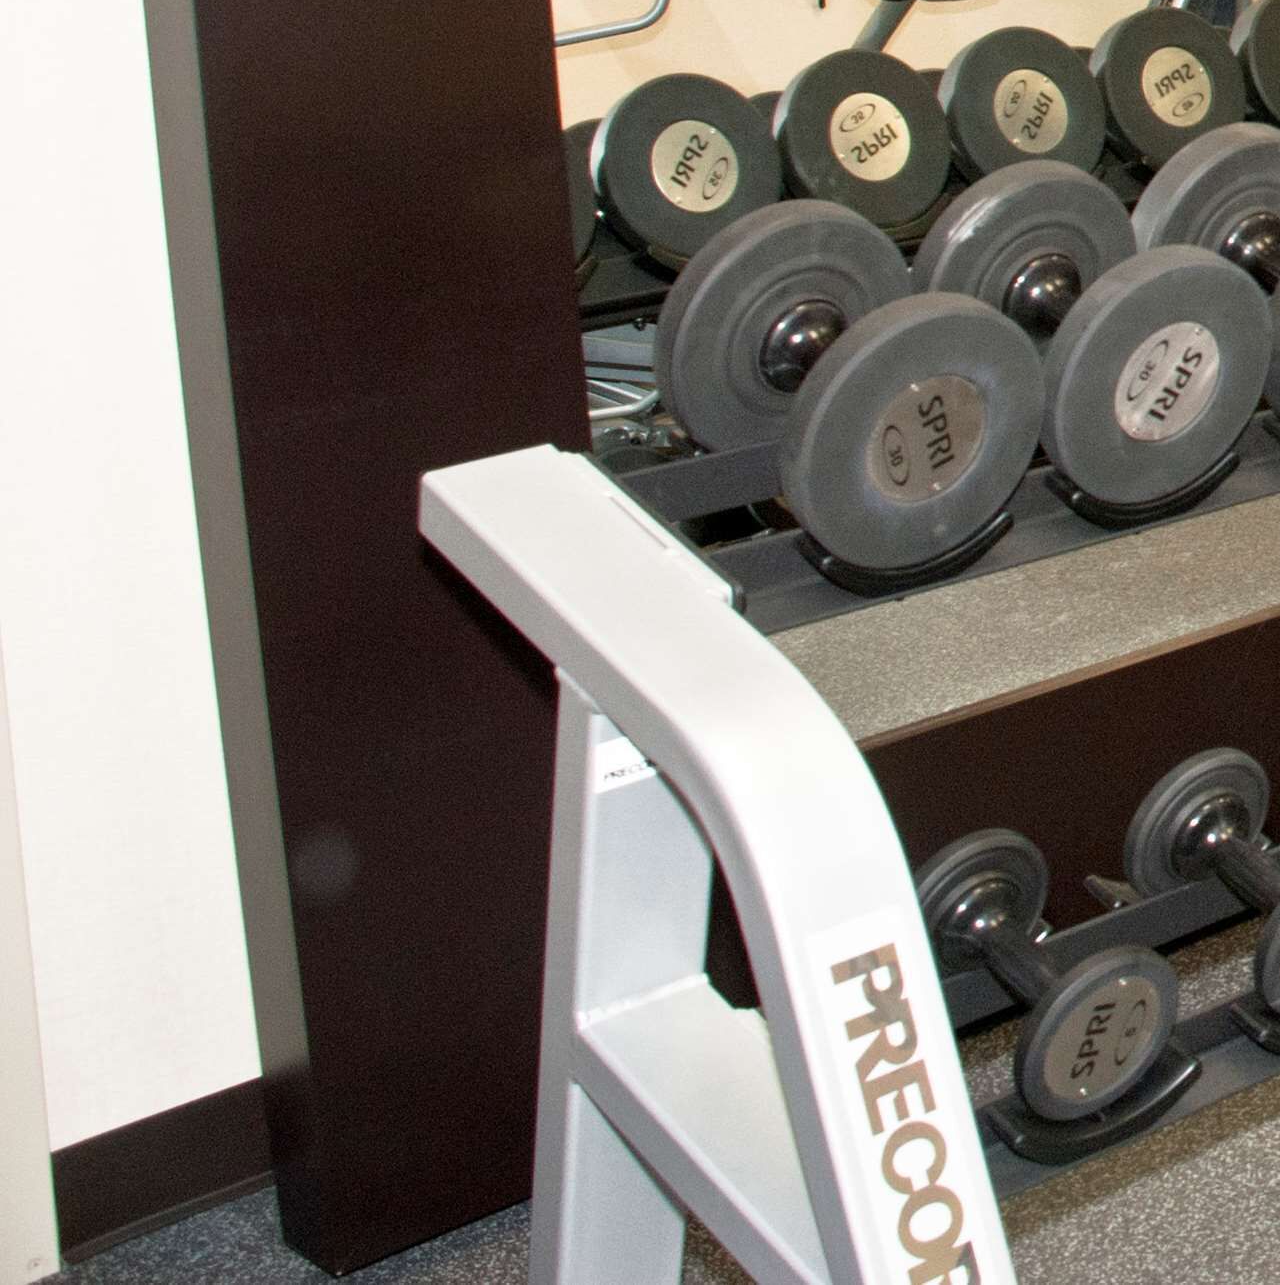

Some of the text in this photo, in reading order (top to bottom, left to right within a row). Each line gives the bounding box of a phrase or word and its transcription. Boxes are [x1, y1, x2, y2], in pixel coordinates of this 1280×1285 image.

[1148, 347, 1203, 421] SPRI
[889, 446, 904, 467] 30
[918, 395, 955, 470] SPRI
[1069, 1002, 1116, 1079] SPRI
